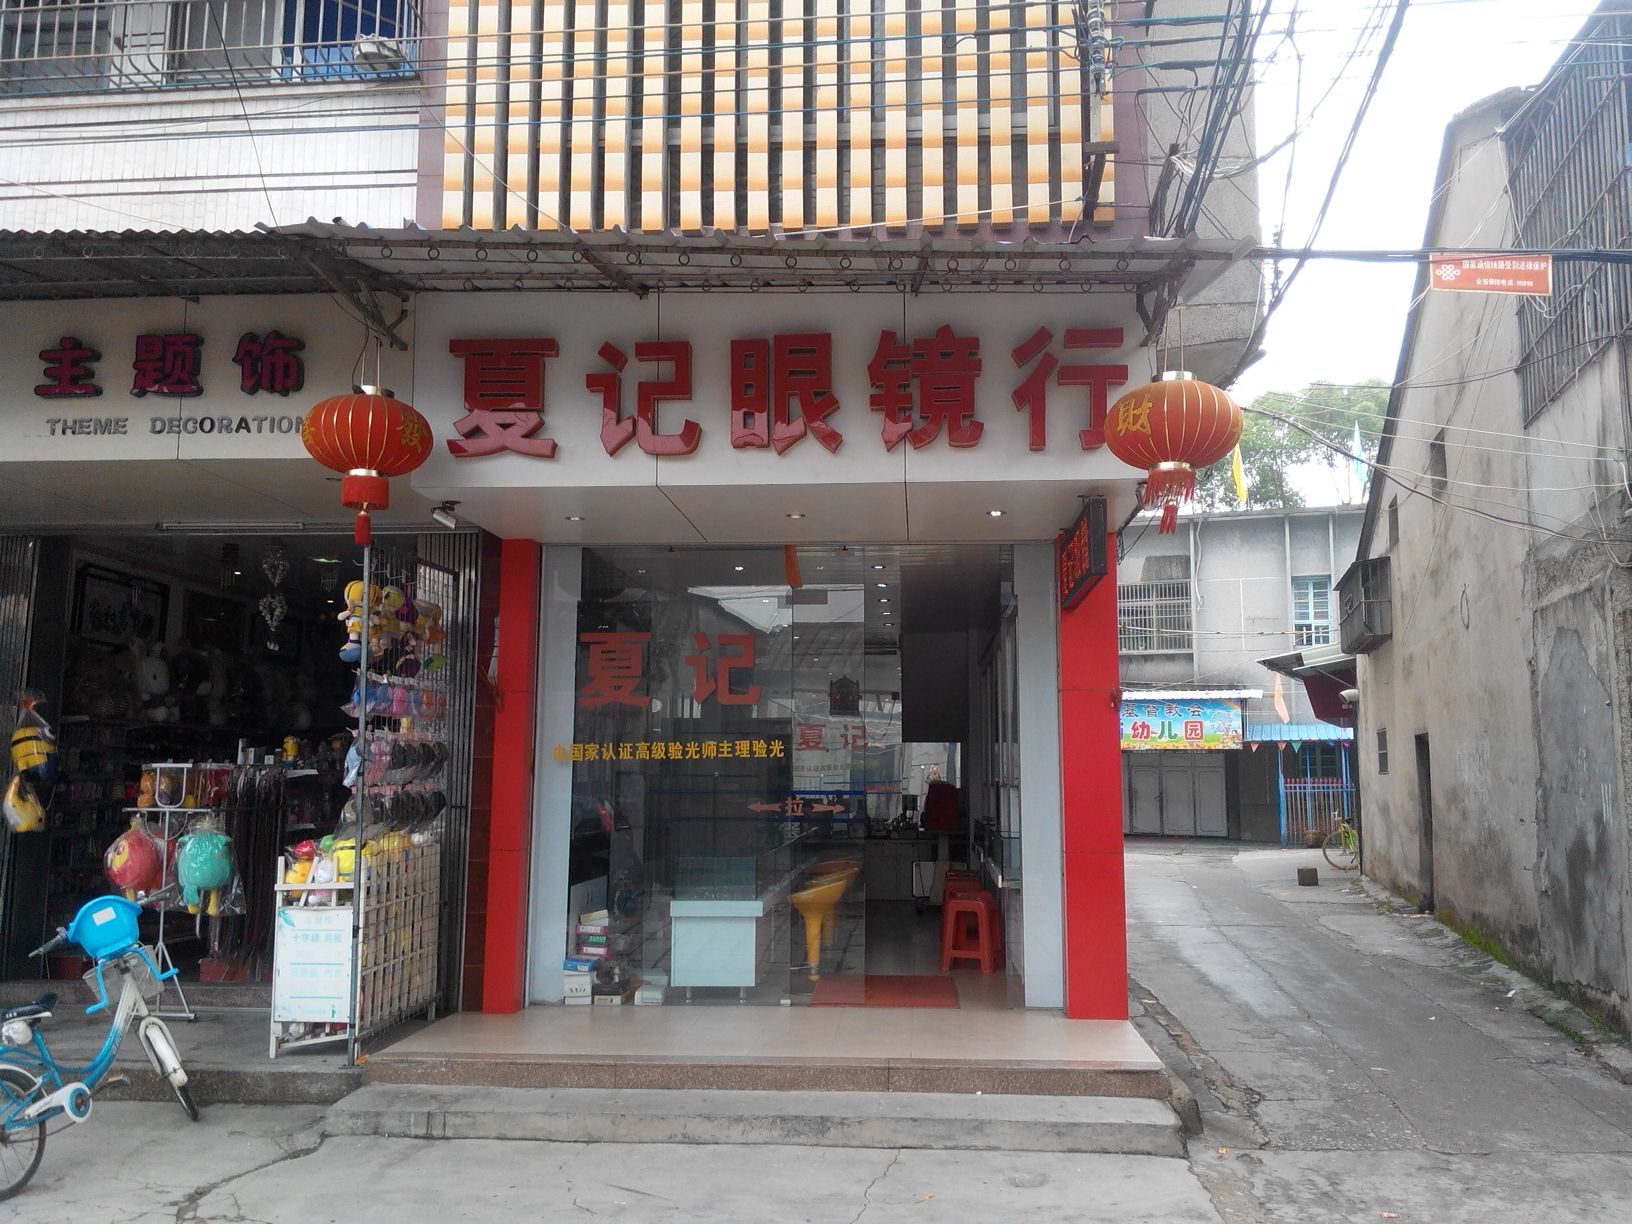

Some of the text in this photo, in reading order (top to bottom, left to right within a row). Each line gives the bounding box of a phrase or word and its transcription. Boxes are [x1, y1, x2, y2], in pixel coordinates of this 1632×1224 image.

[34, 330, 306, 398] 主题饰
[447, 324, 1129, 458] 夏记眼镜行
[46, 416, 129, 436] THEME
[576, 631, 761, 709] 夏记
[1121, 703, 1205, 718] 基督教会
[796, 721, 870, 753] 夏记
[1120, 720, 1205, 741] 幼儿园
[785, 795, 804, 817] 拉
